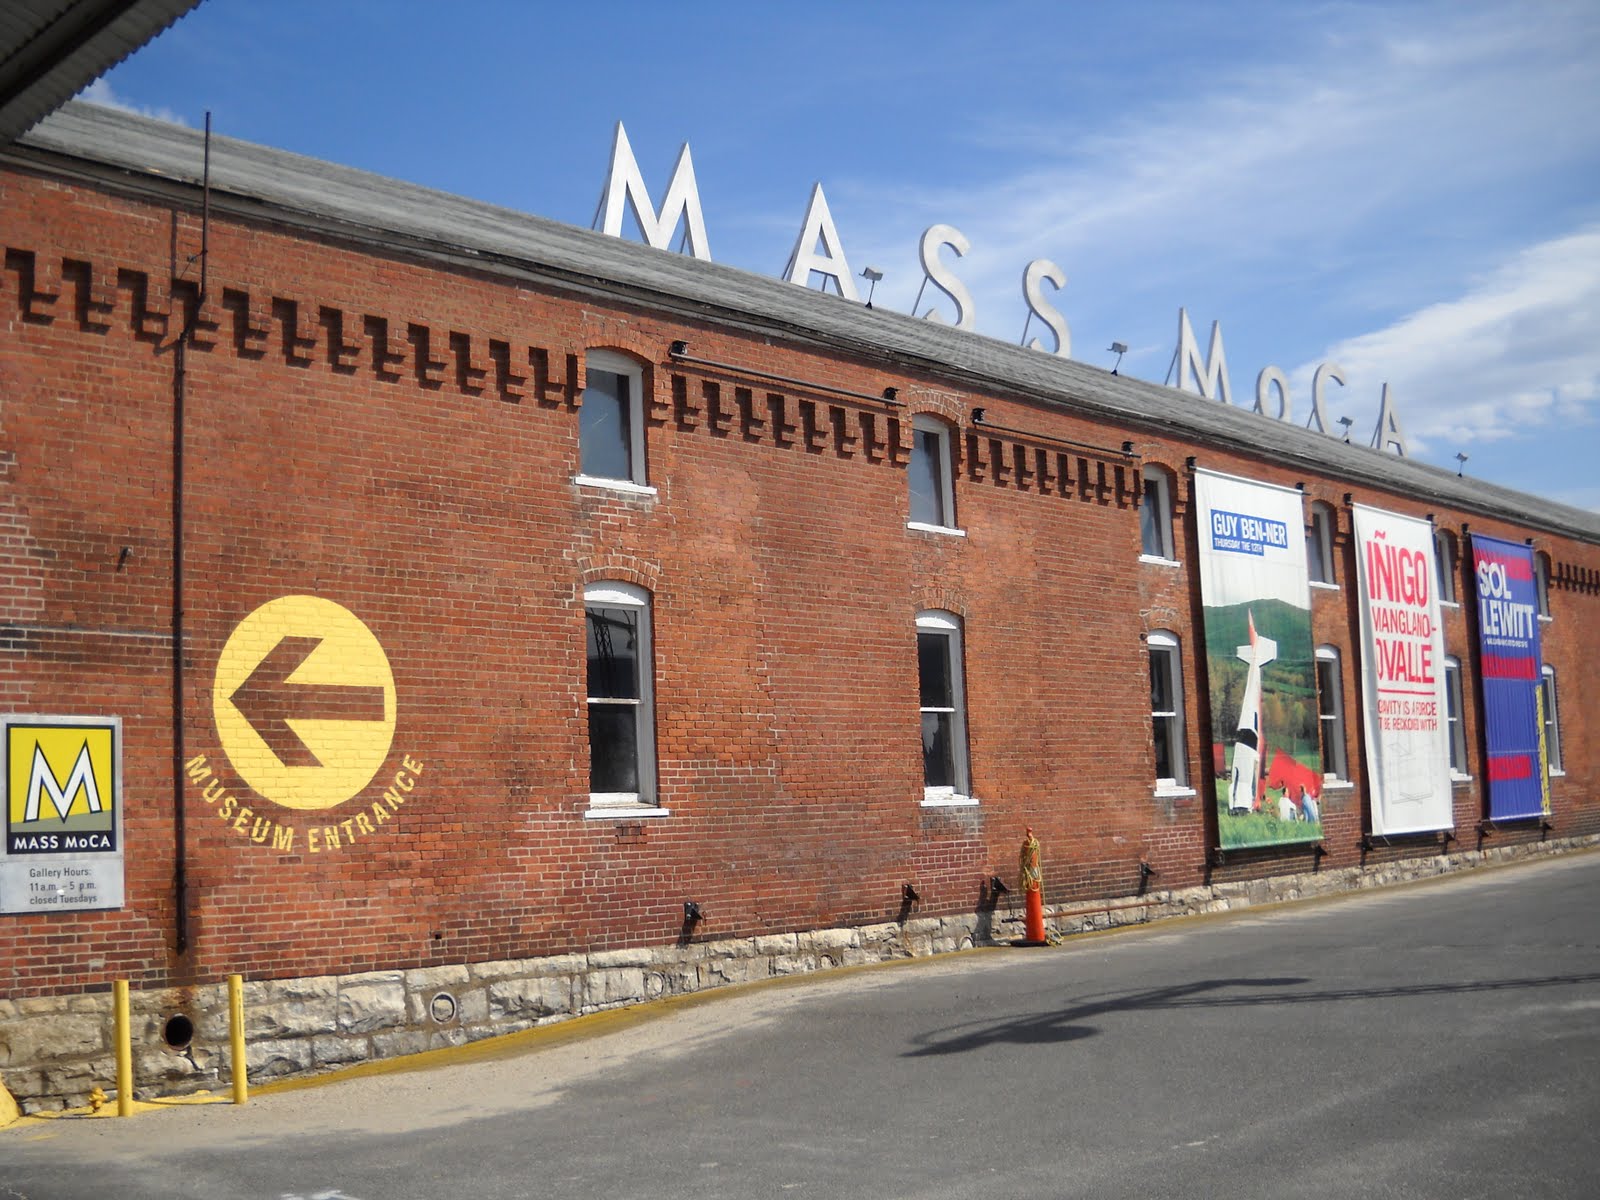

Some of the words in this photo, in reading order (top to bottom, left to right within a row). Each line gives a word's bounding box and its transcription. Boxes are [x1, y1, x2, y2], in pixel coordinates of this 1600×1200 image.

[1213, 513, 1238, 537] GUY
[1240, 517, 1287, 546] BEN-NER
[1214, 538, 1240, 550] THURSDAY
[1241, 541, 1251, 551] THE
[1366, 530, 1428, 608] IÑIGO
[1477, 559, 1512, 600] SOL
[1481, 598, 1534, 639] LEWITT
[23, 738, 103, 824] M
[184, 753, 294, 852] MUSEUM
[307, 754, 424, 853] ENTRANCE
[14, 835, 59, 850] MASS
[65, 834, 111, 848] MoCA
[29, 867, 61, 878] Gallery
[69, 881, 75, 890] 5
[79, 882, 97, 892] p.m.
[29, 895, 58, 905] closed
[60, 894, 97, 904] Tuesdays
